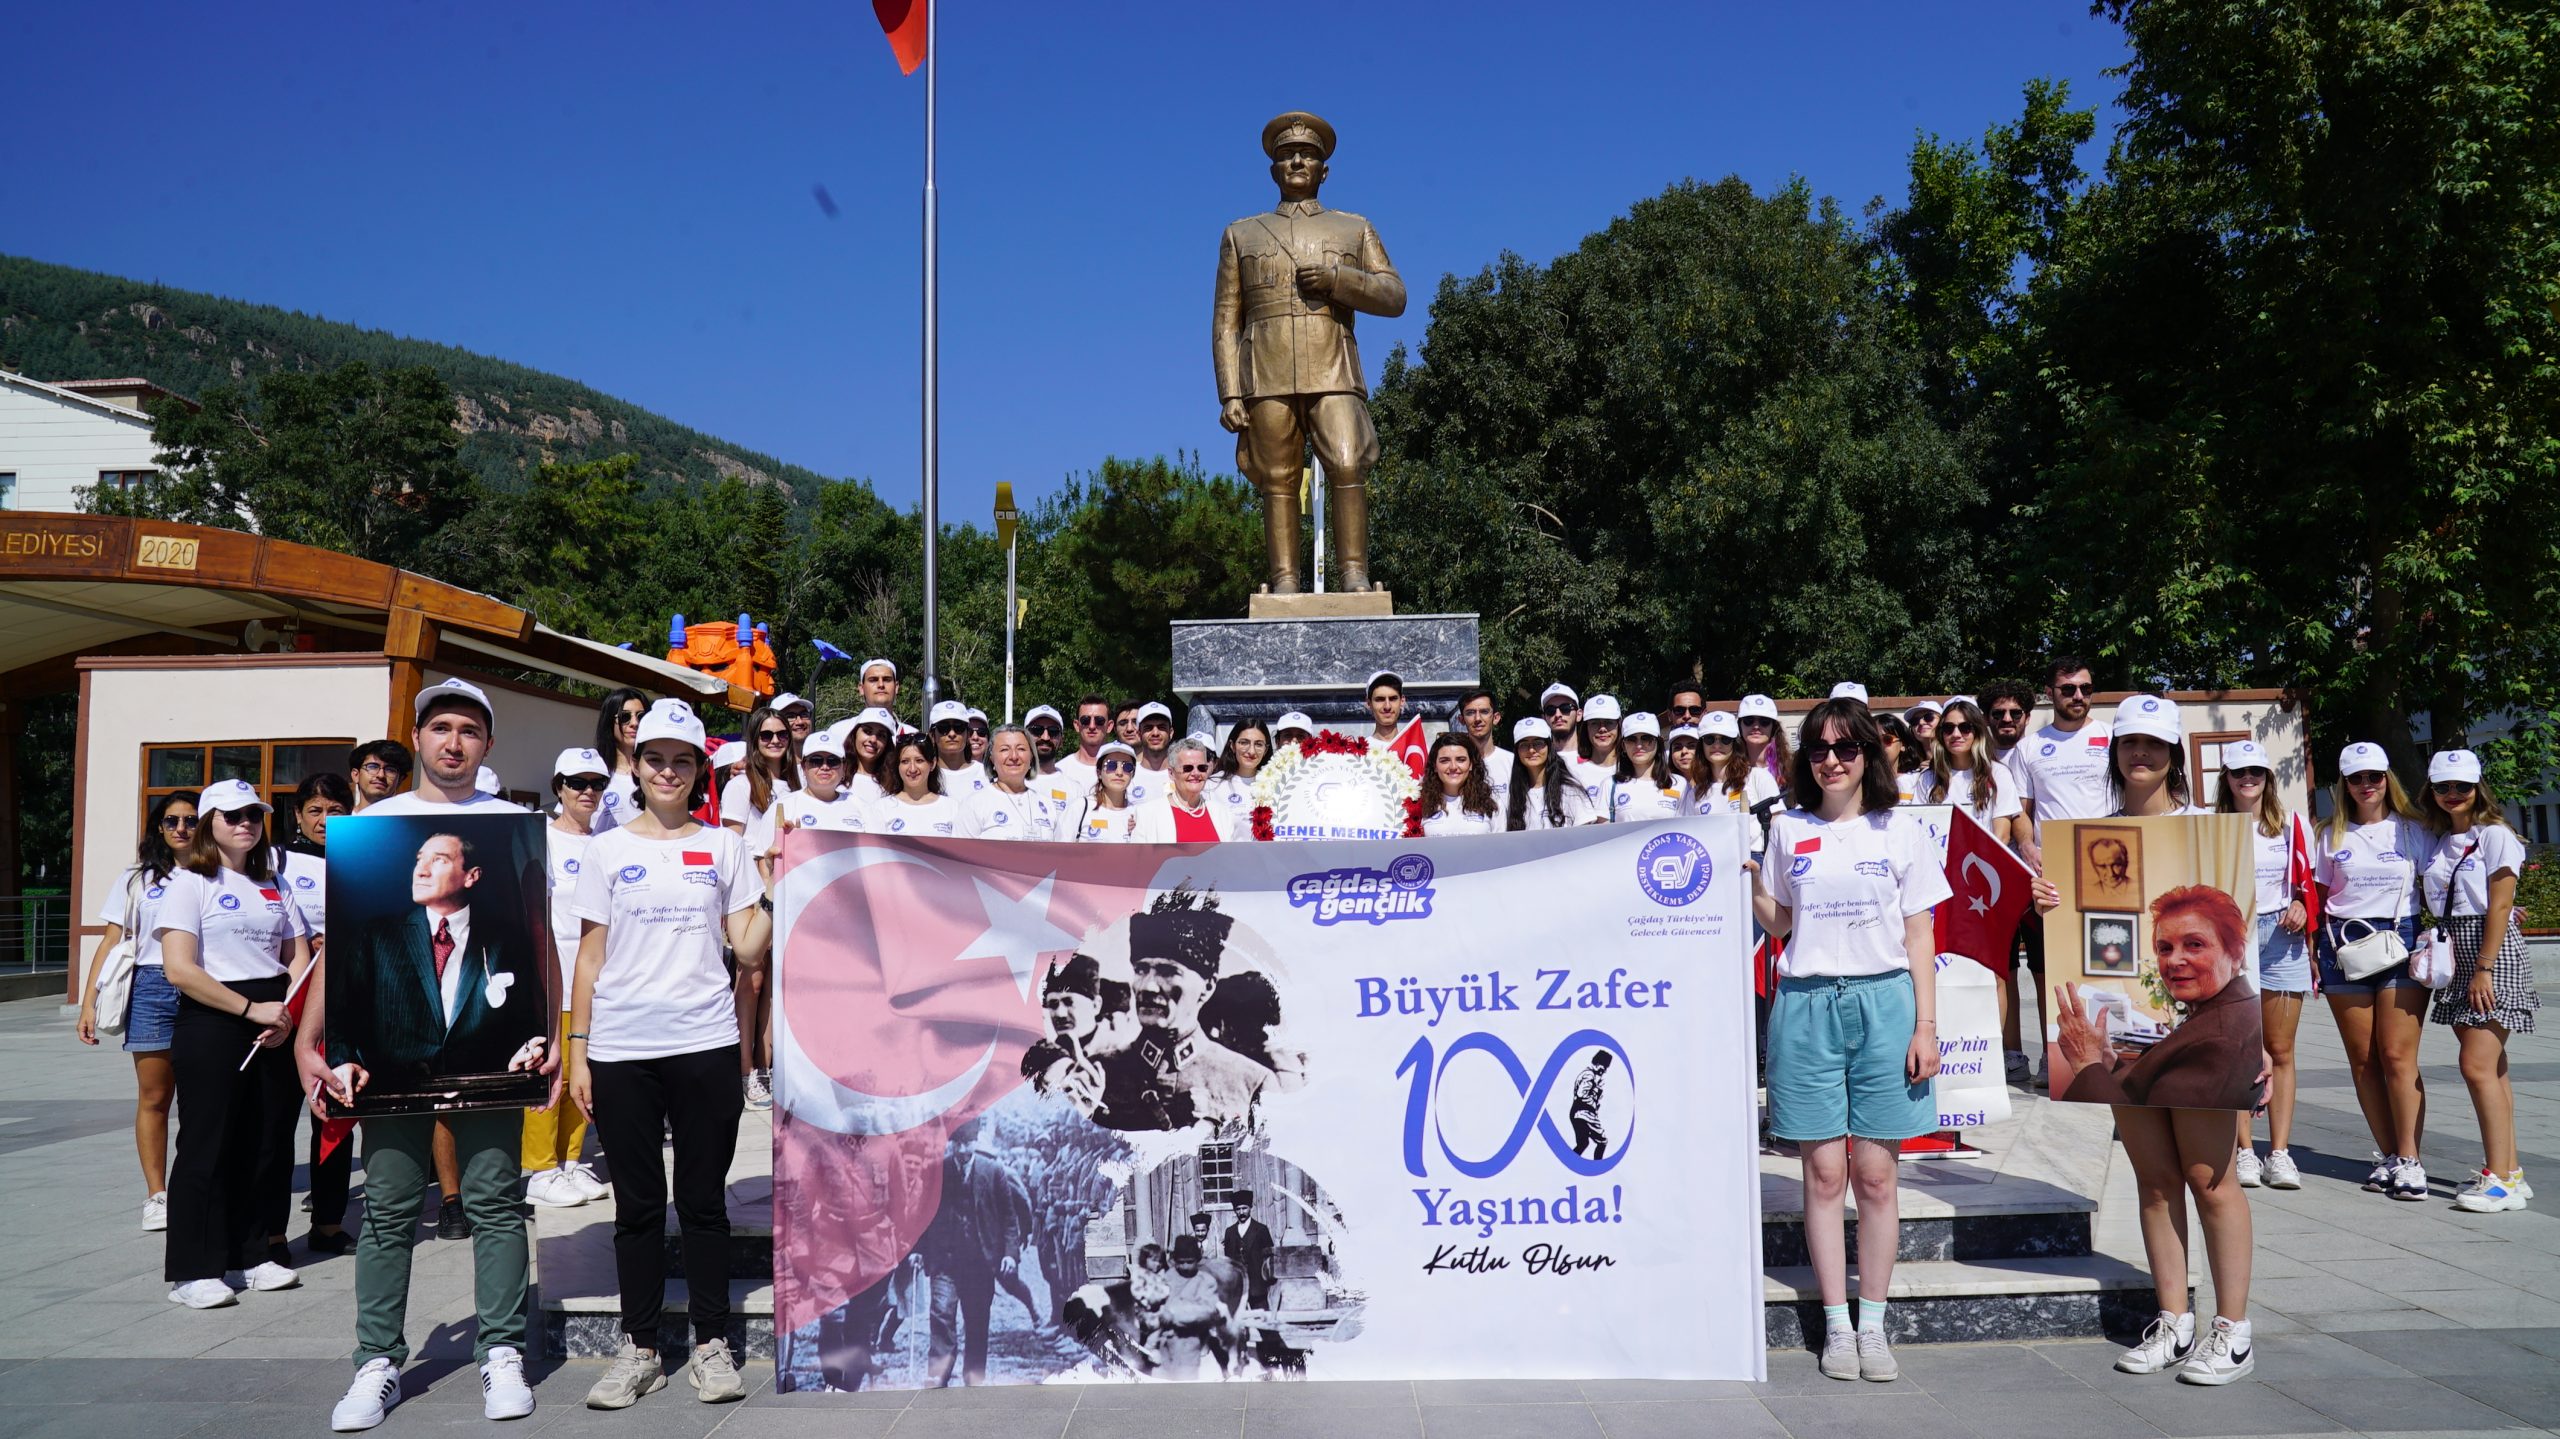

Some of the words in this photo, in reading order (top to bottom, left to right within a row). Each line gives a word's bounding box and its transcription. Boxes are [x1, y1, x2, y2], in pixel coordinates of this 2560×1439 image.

[0, 529, 104, 557] EDİYESİ
[141, 540, 195, 567] 2020
[1275, 825, 1326, 837] GENEL
[1292, 873, 1394, 900] çağdaş
[1638, 866, 1684, 905] DESTEKLEME
[1319, 891, 1427, 920] gençlik
[1627, 914, 1664, 926] Çağdaş
[1667, 913, 1724, 925] Türkiye'nin
[1630, 928, 1668, 937] Gelecek
[1671, 927, 1722, 937] Güvencesi
[1355, 971, 1520, 1026] Büyük
[1535, 968, 1673, 1009] Zafer
[1936, 1036, 1989, 1057] iye'nin
[1940, 1058, 1983, 1075] ncesi
[1395, 1029, 1636, 1179] 100
[1939, 1110, 1985, 1127] BESİ
[1412, 1184, 1624, 1239] Yaşında!
[1422, 1244, 1510, 1277] Kutlu
[1522, 1243, 1616, 1276] Olsun
